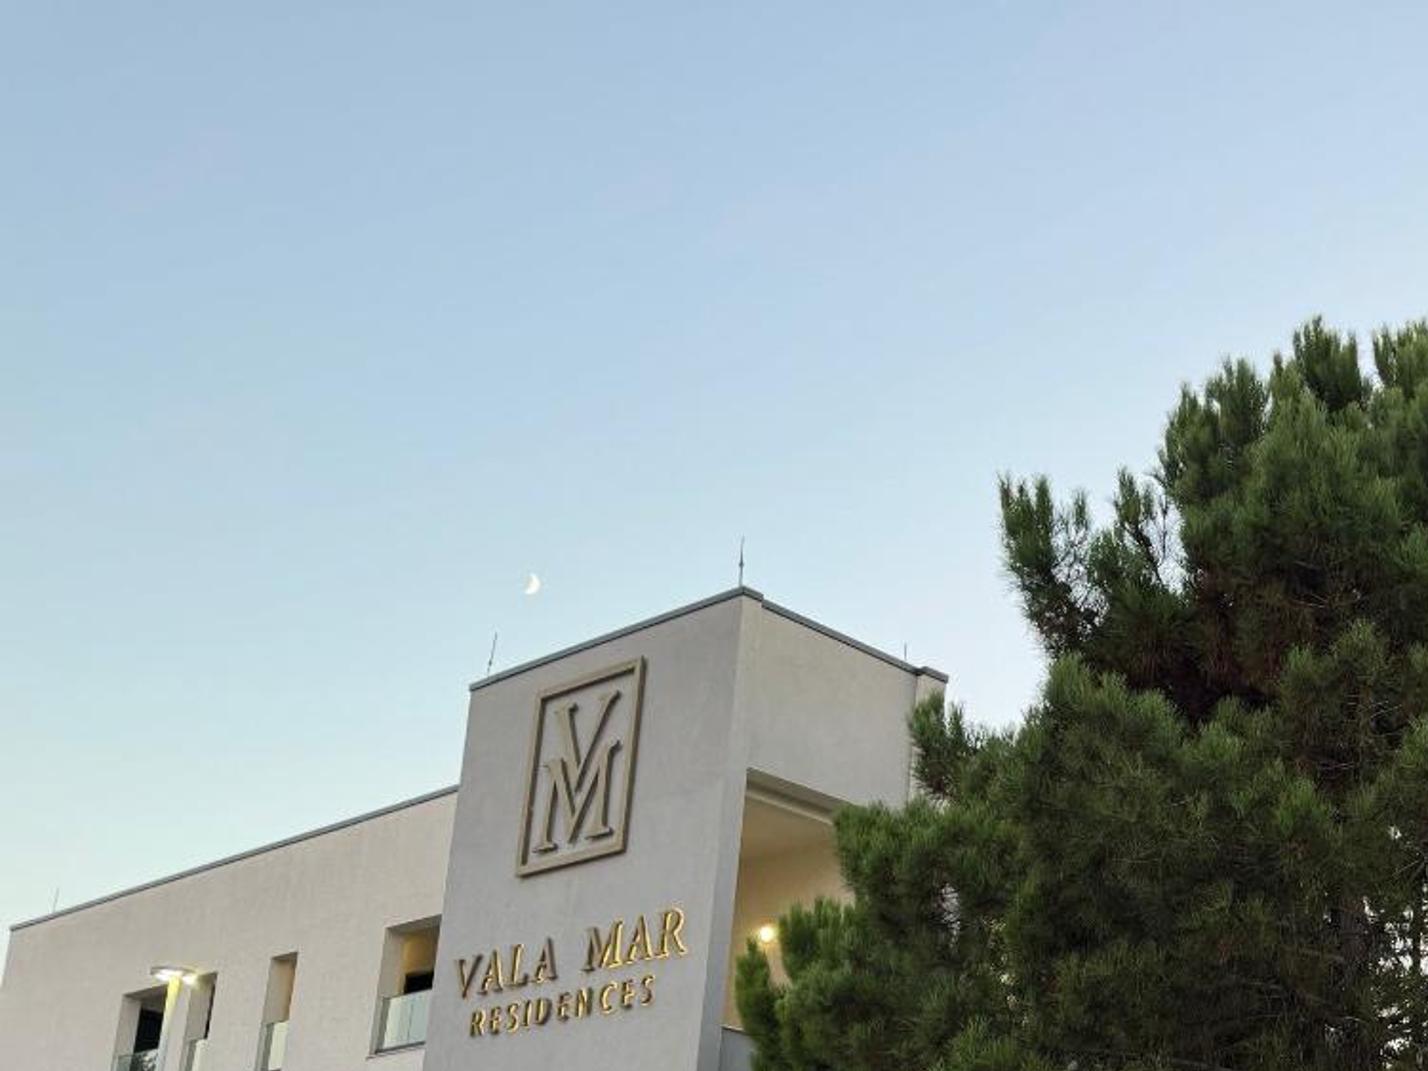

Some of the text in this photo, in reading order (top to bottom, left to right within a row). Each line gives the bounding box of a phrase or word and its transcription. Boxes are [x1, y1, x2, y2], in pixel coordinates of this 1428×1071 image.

[455, 907, 688, 998] VALA MAR
[470, 974, 656, 1037] RESIDENCES
